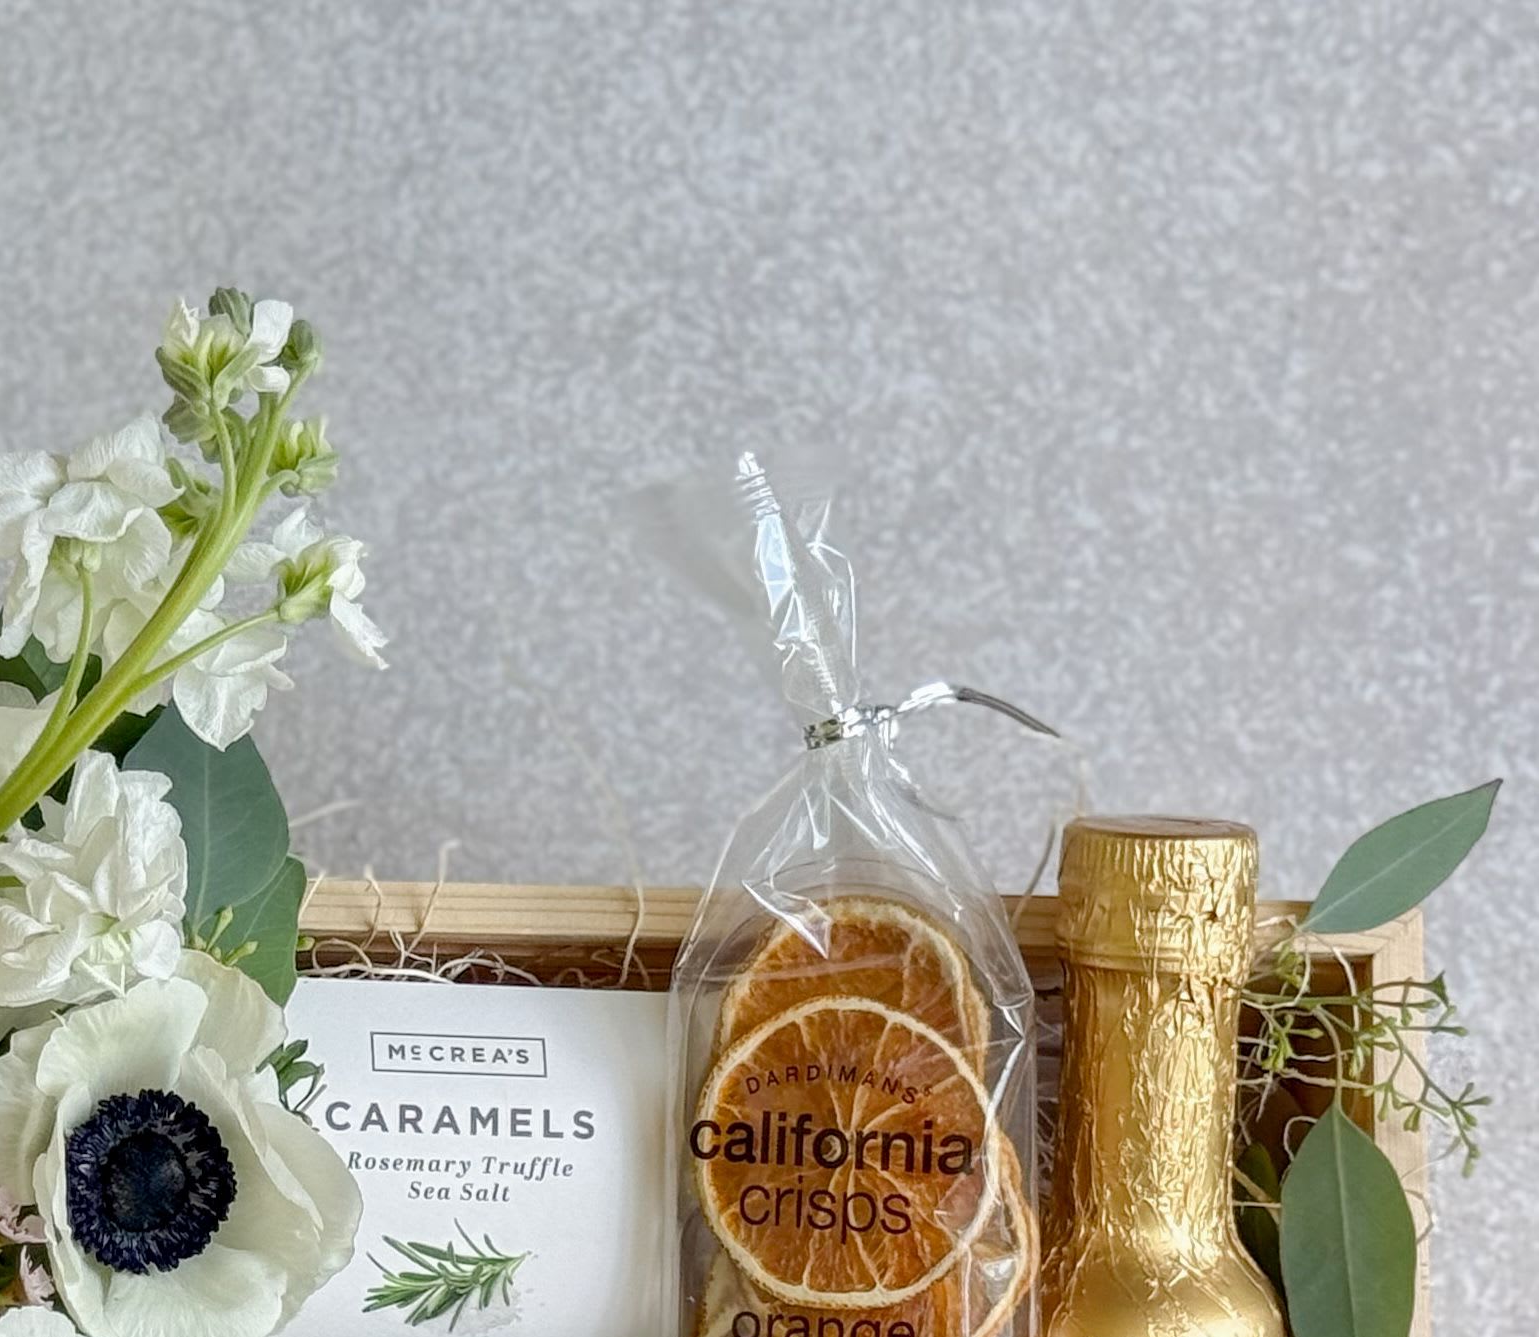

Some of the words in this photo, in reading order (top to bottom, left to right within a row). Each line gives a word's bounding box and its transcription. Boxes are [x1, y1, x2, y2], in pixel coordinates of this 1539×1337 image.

[325, 1100, 596, 1141] CARAMELS
[689, 1110, 975, 1177] california
[347, 1151, 472, 1178] Rosemary
[481, 1156, 574, 1181] Truffle
[407, 1181, 451, 1201] Sea
[459, 1182, 511, 1203] Salt
[738, 1175, 913, 1244] crisps
